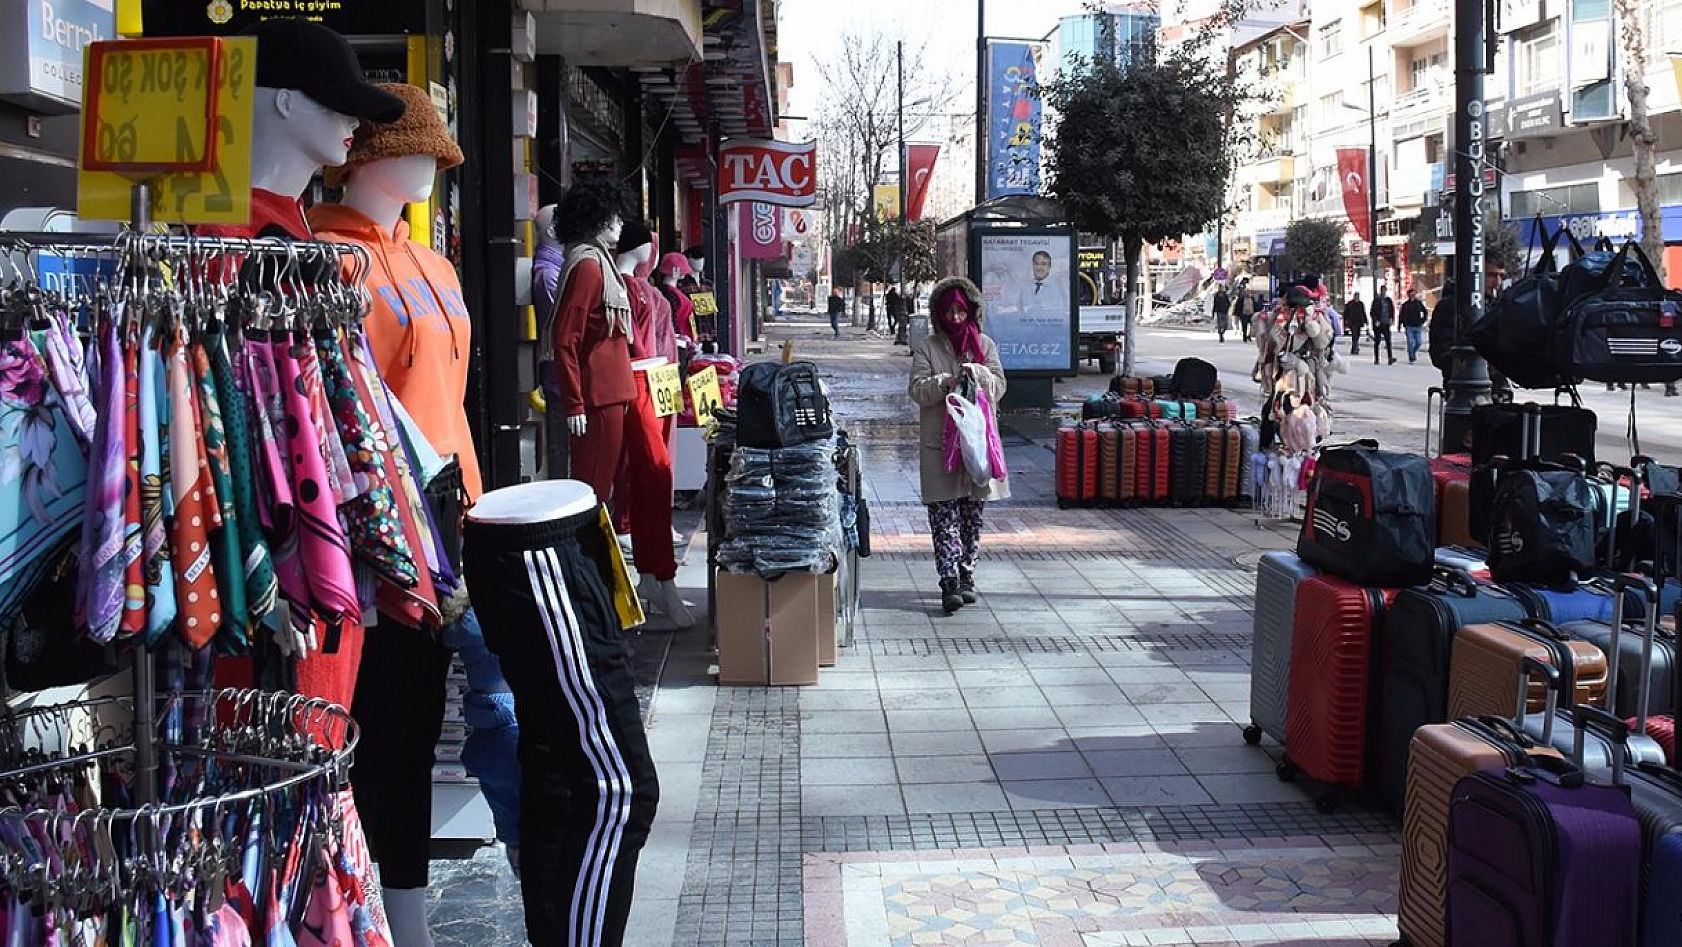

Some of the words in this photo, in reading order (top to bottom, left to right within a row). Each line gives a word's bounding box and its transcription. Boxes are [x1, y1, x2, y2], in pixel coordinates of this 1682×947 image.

[43, 62, 83, 85] COLLEC
[723, 153, 810, 196] TAÇ
[657, 387, 672, 414] 99
